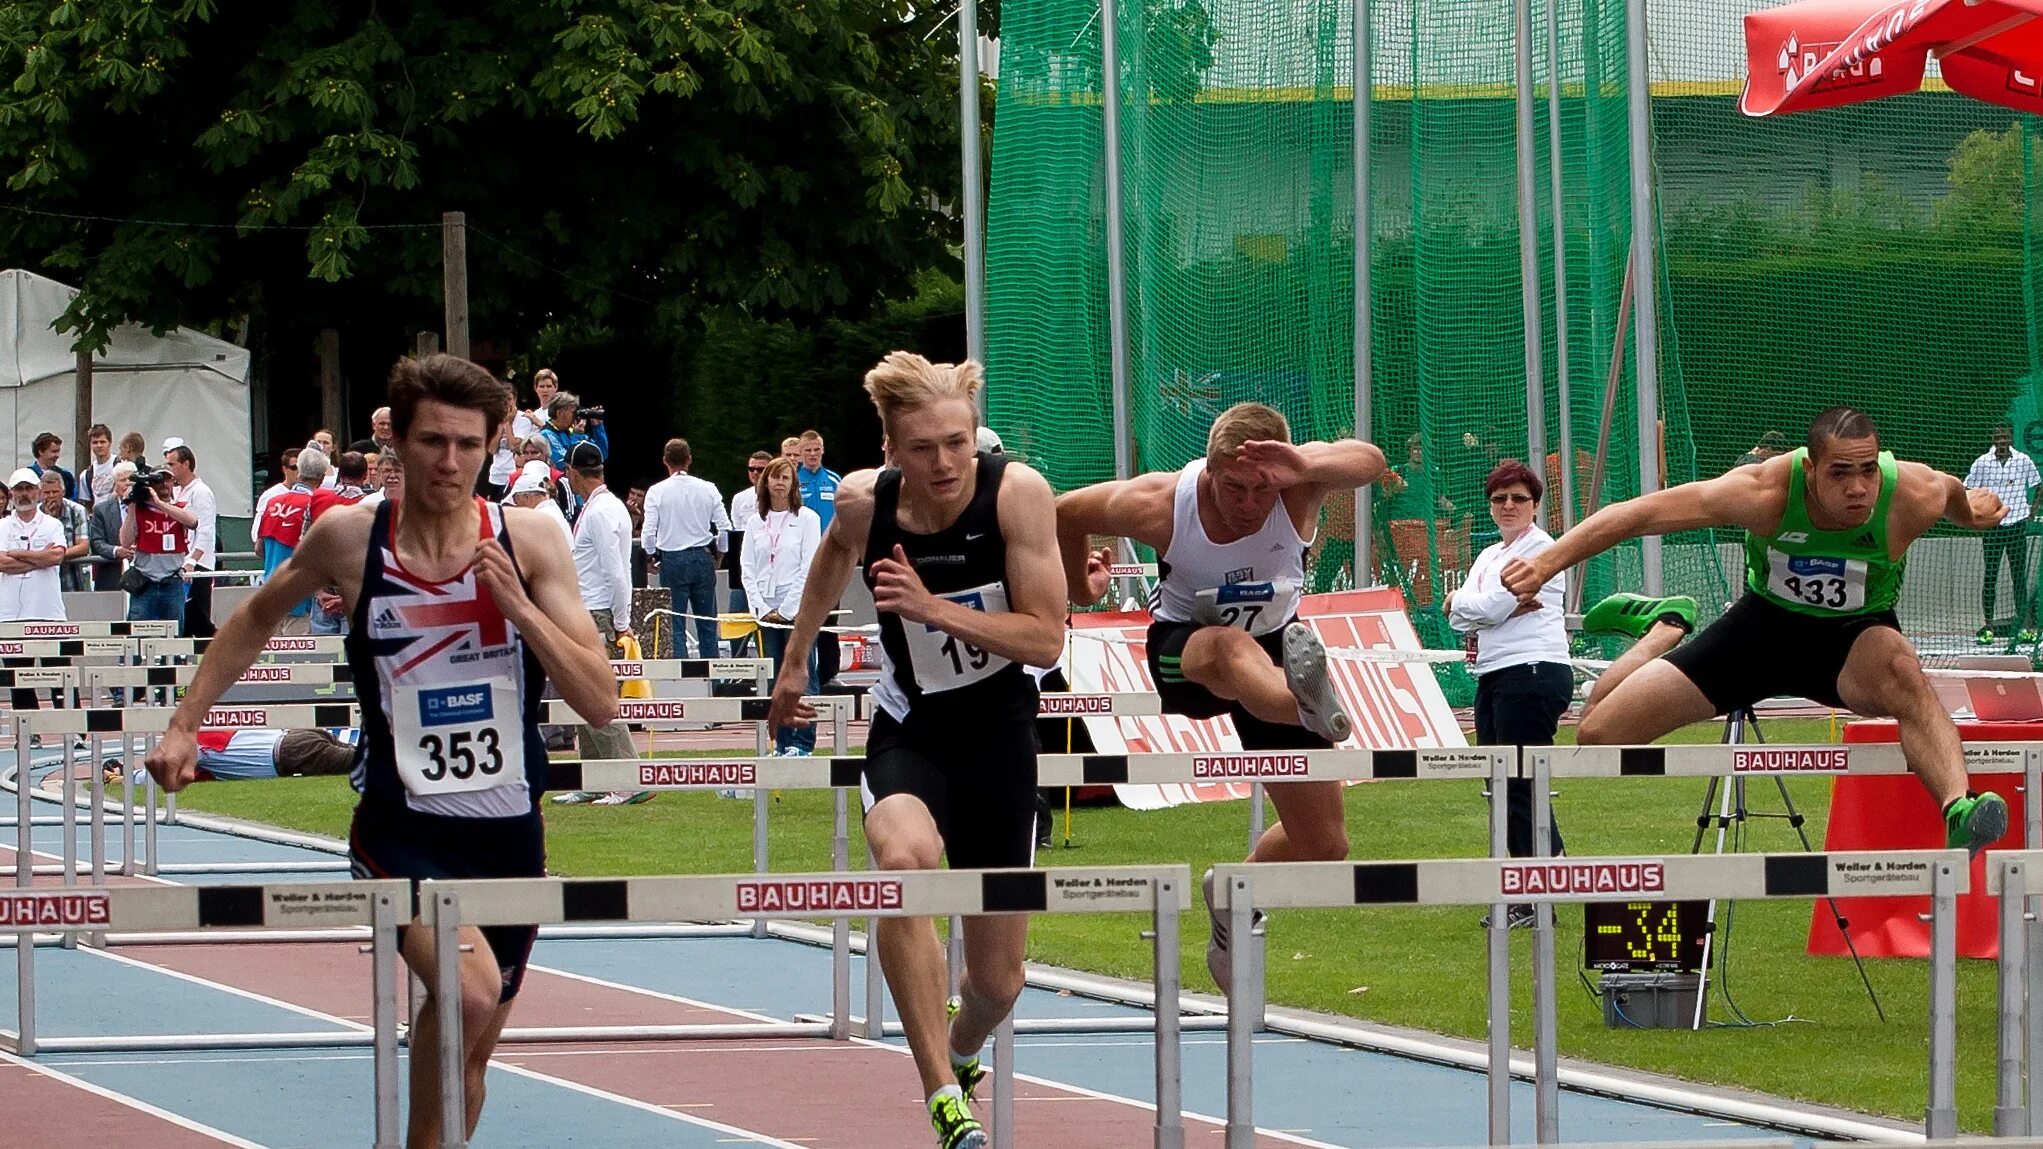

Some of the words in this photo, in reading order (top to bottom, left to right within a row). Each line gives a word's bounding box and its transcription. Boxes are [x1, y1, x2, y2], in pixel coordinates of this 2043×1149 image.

[1784, 575, 1847, 608] 433
[1221, 605, 1264, 632] 27
[24, 626, 80, 635] BAUHAUS
[941, 633, 990, 676] 19
[447, 692, 484, 708] BASF
[419, 727, 503, 781] 353
[1734, 751, 1848, 770] BAUHAUS
[641, 765, 756, 784] BAUHAUS
[1195, 755, 1308, 777] BAUHAUS
[1874, 862, 1882, 871] &
[1094, 878, 1102, 887] &
[1502, 865, 1663, 894] BAUHAUS
[737, 882, 901, 911] BAUHAUS
